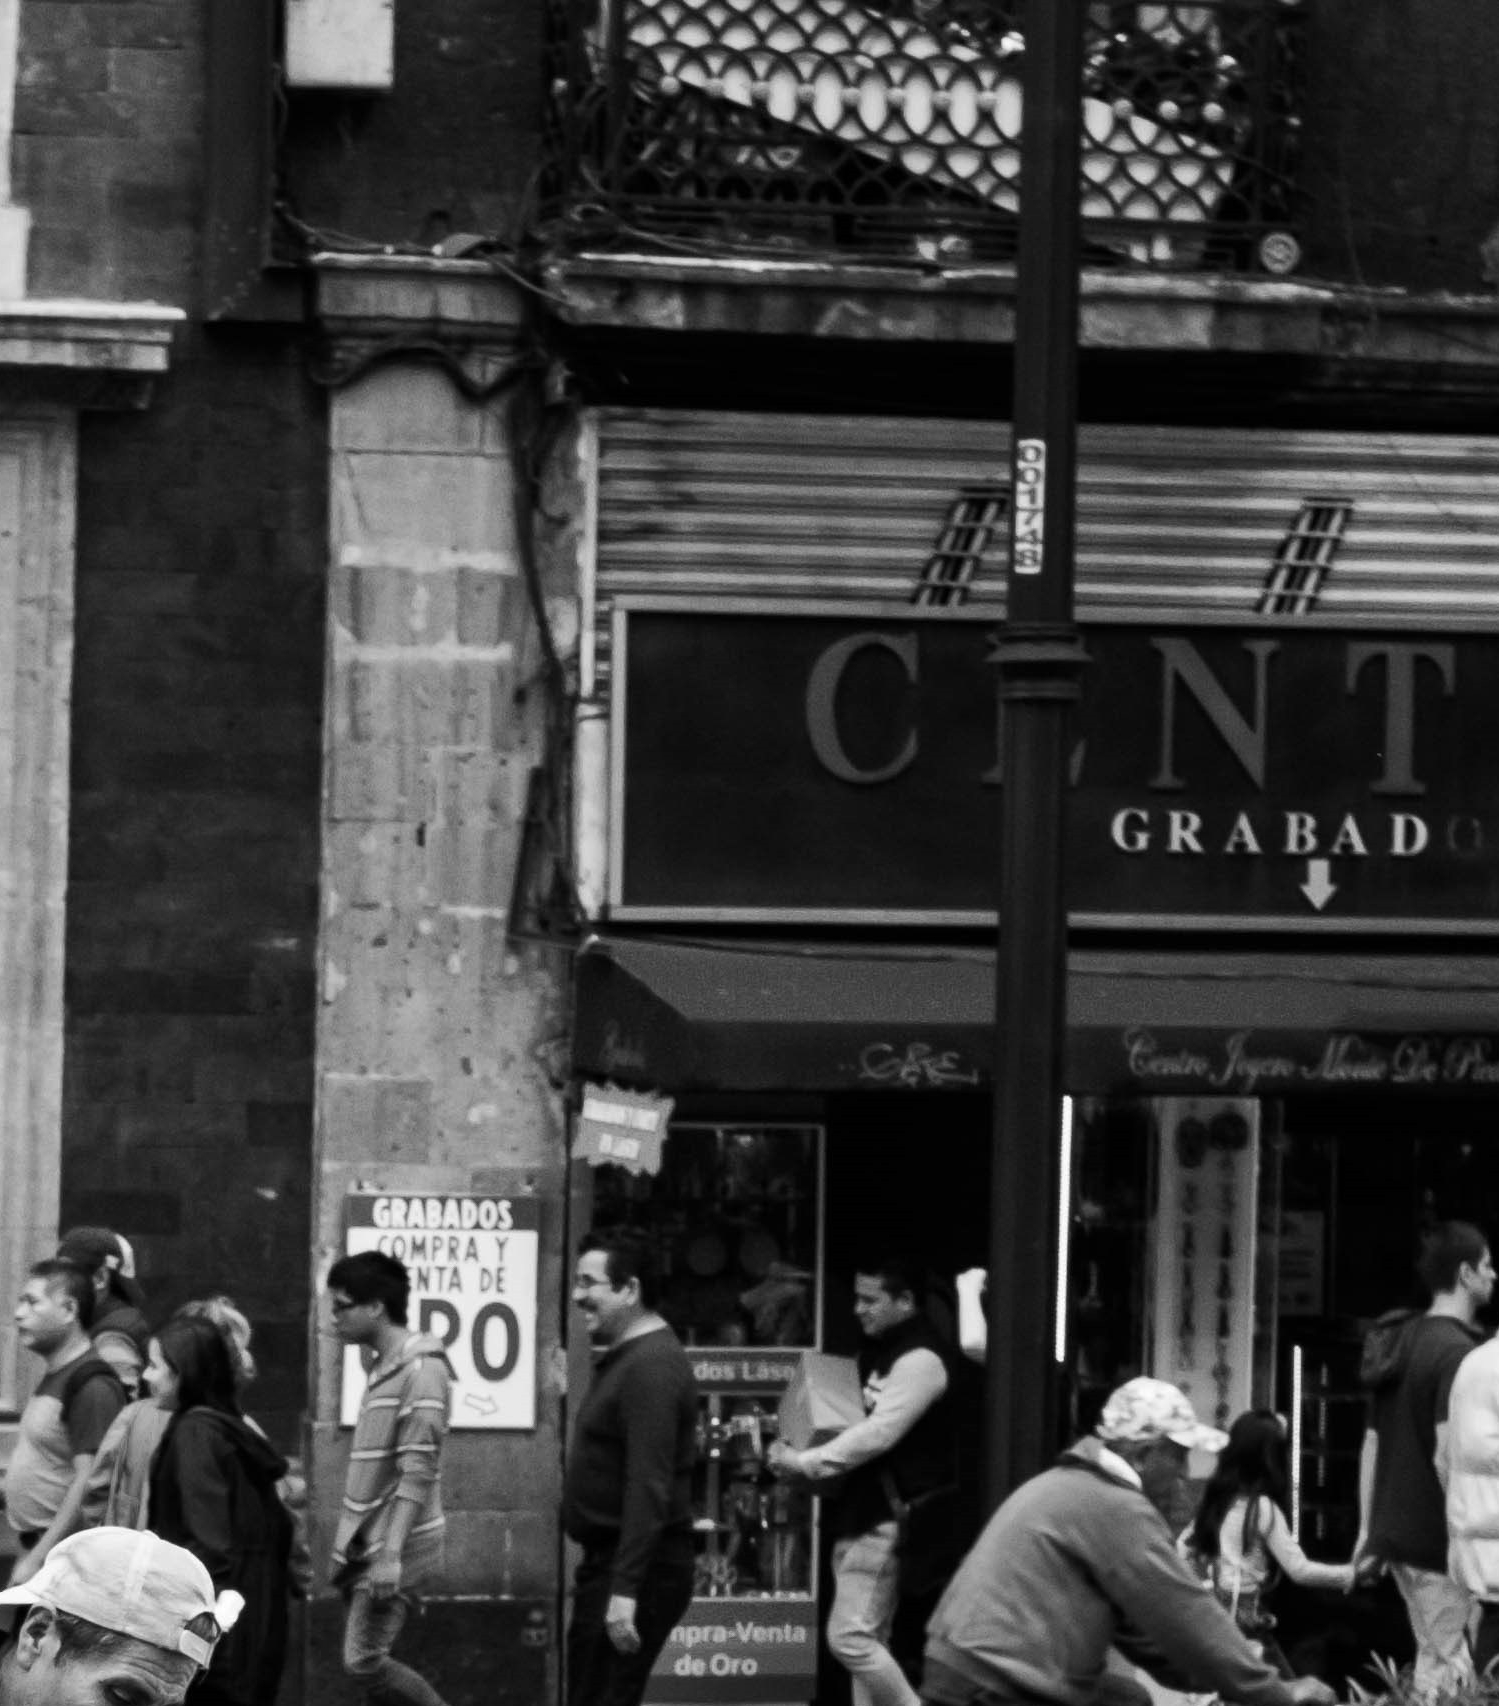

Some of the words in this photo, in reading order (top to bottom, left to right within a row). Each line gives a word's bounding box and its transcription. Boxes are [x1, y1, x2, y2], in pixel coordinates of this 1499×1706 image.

[372, 1197, 514, 1230] GRABADOS
[496, 1236, 510, 1263] Y
[480, 1266, 507, 1293] DE
[674, 1652, 707, 1677] de
[709, 1652, 759, 1677] Oro
